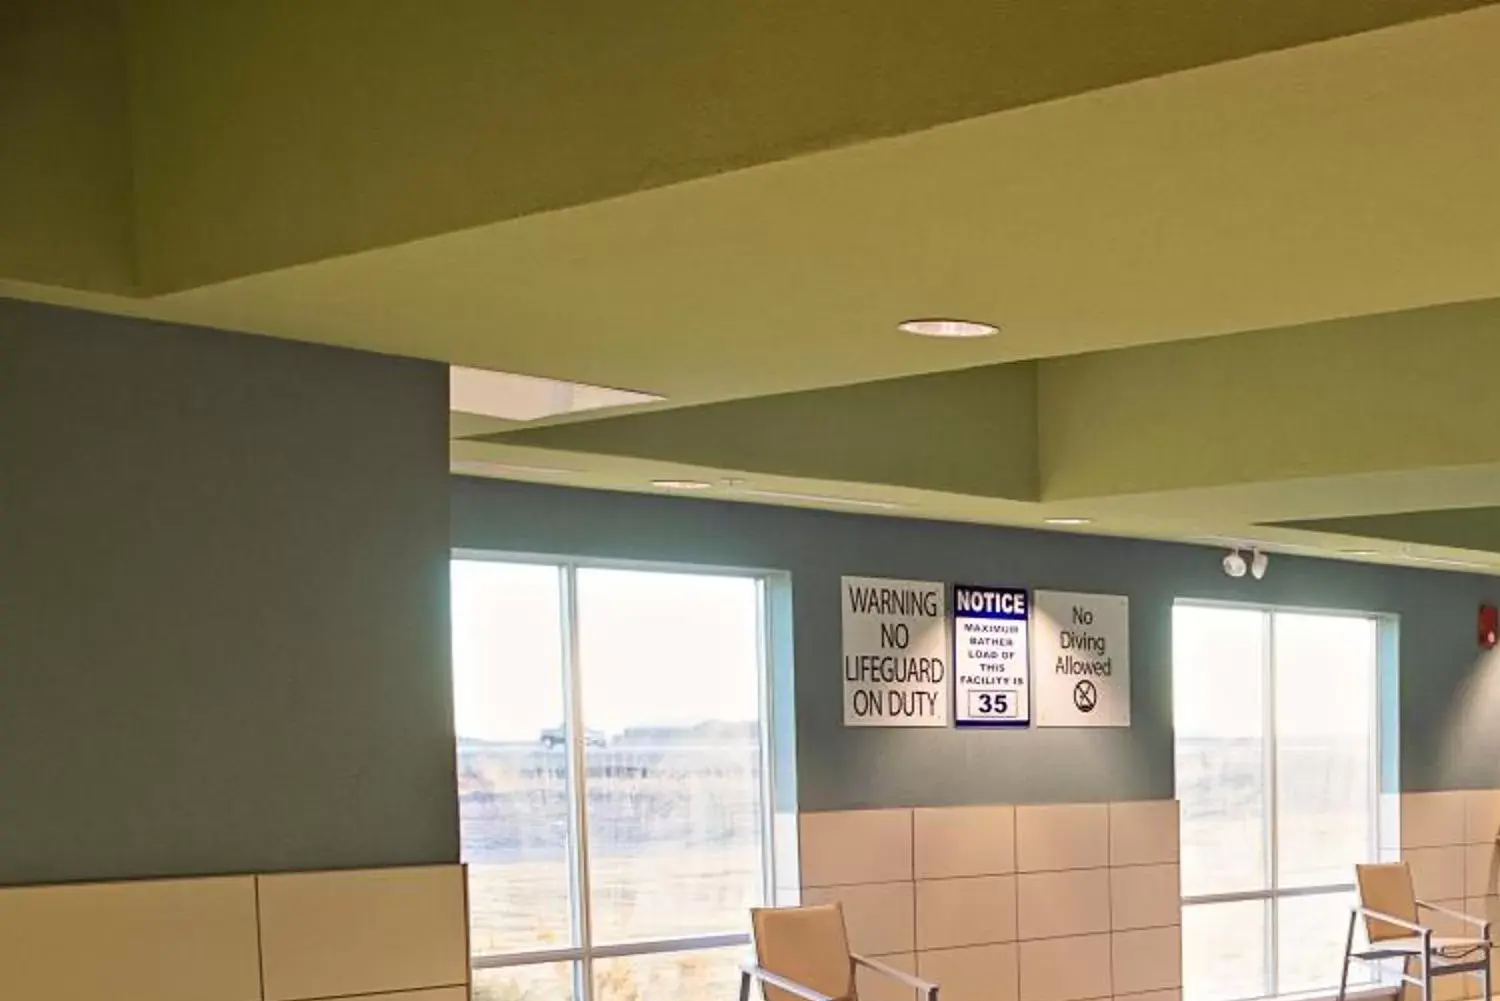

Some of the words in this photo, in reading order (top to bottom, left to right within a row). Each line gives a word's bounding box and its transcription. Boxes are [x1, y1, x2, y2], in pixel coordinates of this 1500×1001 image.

[848, 585, 937, 617] WARNING
[957, 589, 1025, 614] NOTICE
[1072, 605, 1093, 625] No
[881, 623, 909, 649] NO
[963, 623, 1019, 633] MAXIMUM
[969, 637, 1013, 646] BATHER
[1060, 631, 1105, 656] Diving
[968, 650, 999, 659] LOAD
[1001, 651, 1015, 660] OF
[845, 655, 945, 683] LIFEGUARD
[980, 663, 1005, 672] THIS
[1055, 655, 1112, 677] Allowed
[959, 675, 1009, 685] FACILITY
[1013, 677, 1024, 685] IS
[853, 689, 883, 717] ON
[888, 690, 938, 717] DUTY
[978, 693, 1008, 713] 35
